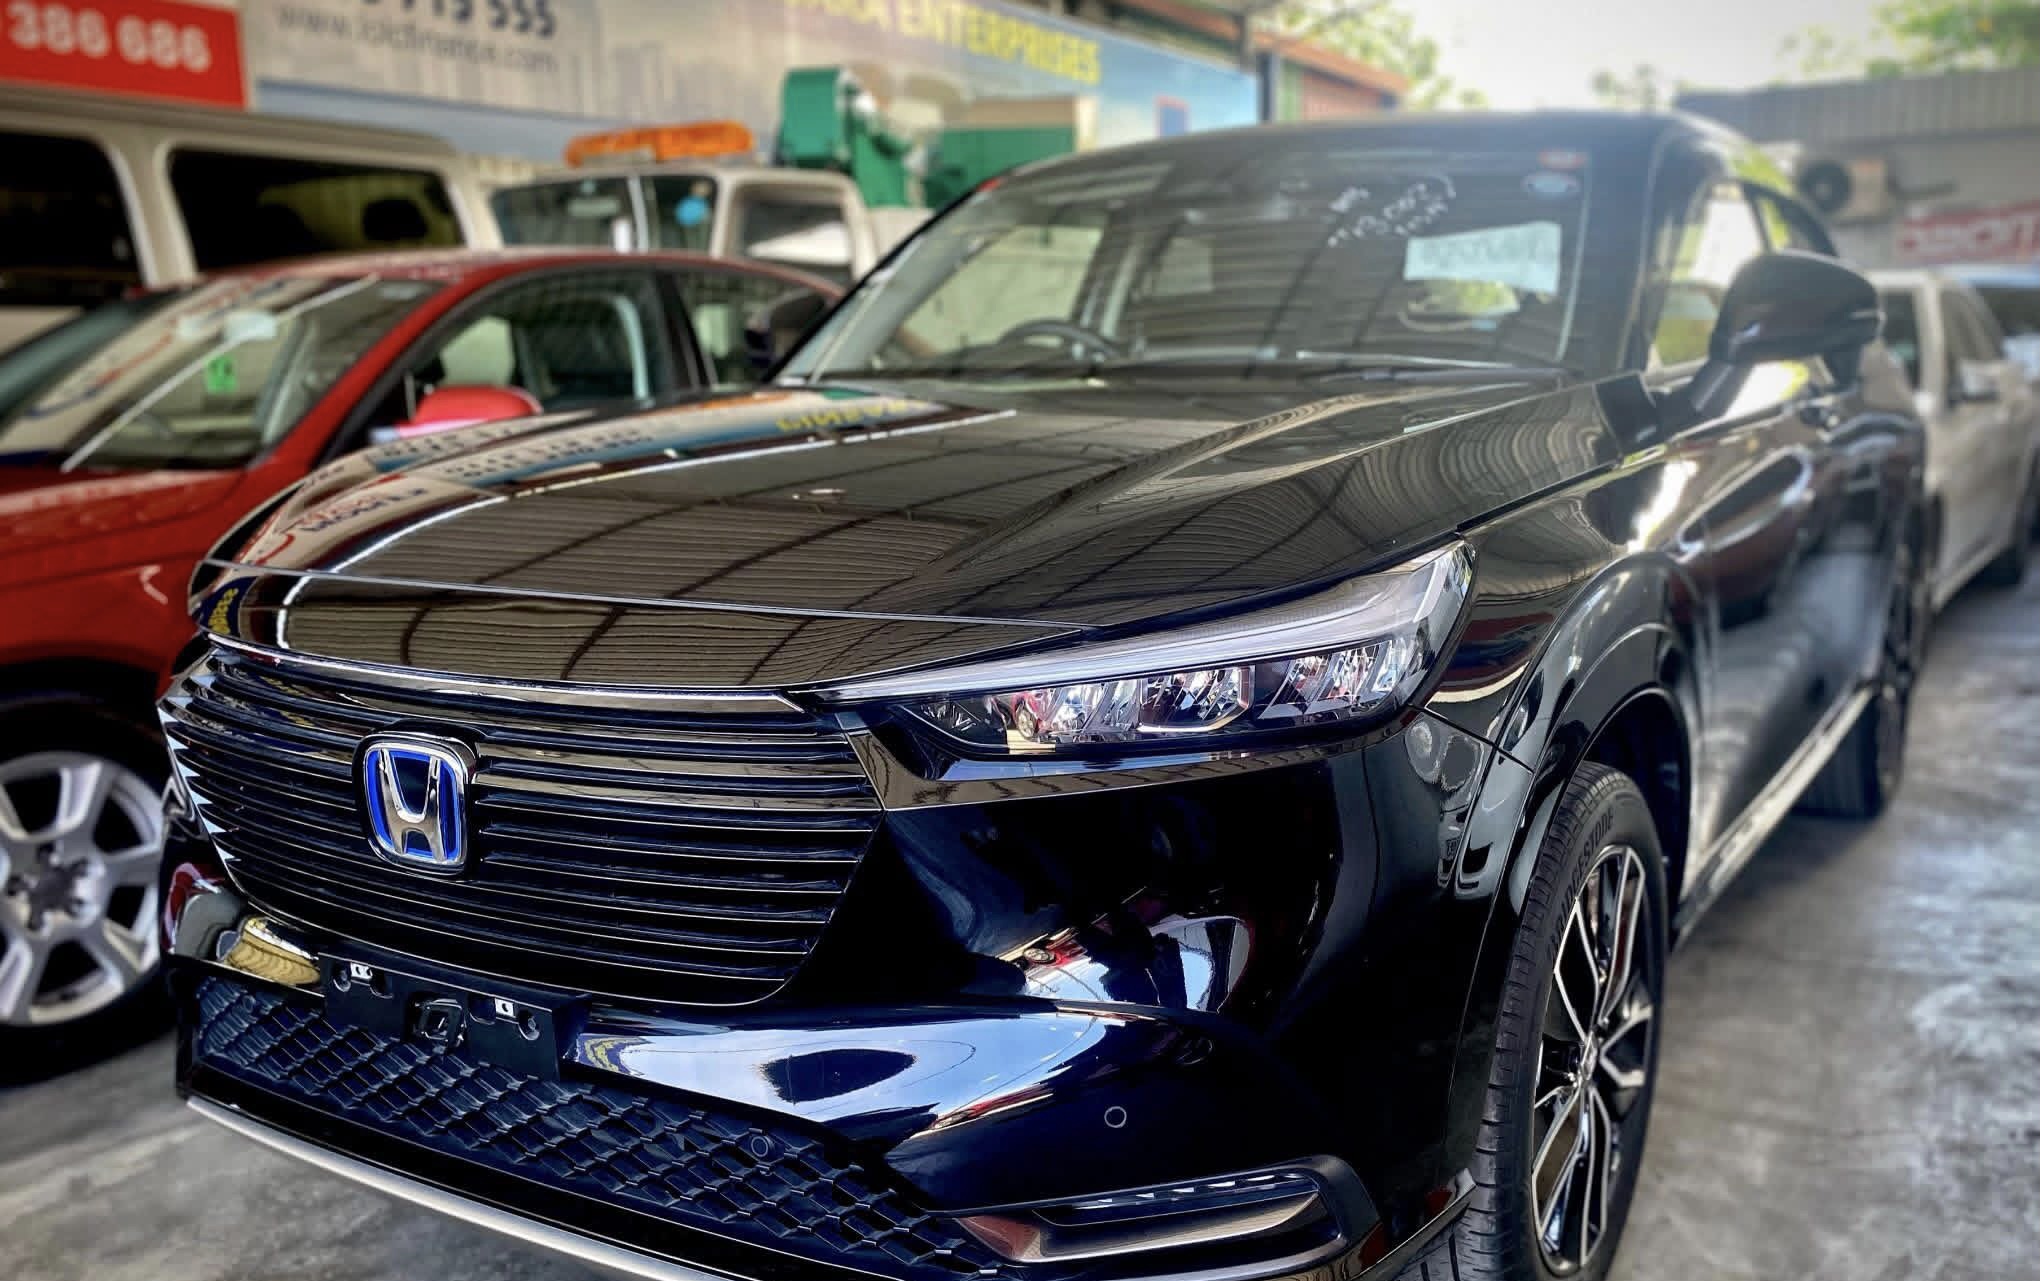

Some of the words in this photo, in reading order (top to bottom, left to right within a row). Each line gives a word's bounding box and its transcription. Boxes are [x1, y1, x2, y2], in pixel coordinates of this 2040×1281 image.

[8, 1, 110, 60] 386
[115, 14, 212, 74] 686
[898, 0, 1099, 85] ENTERPRISES
